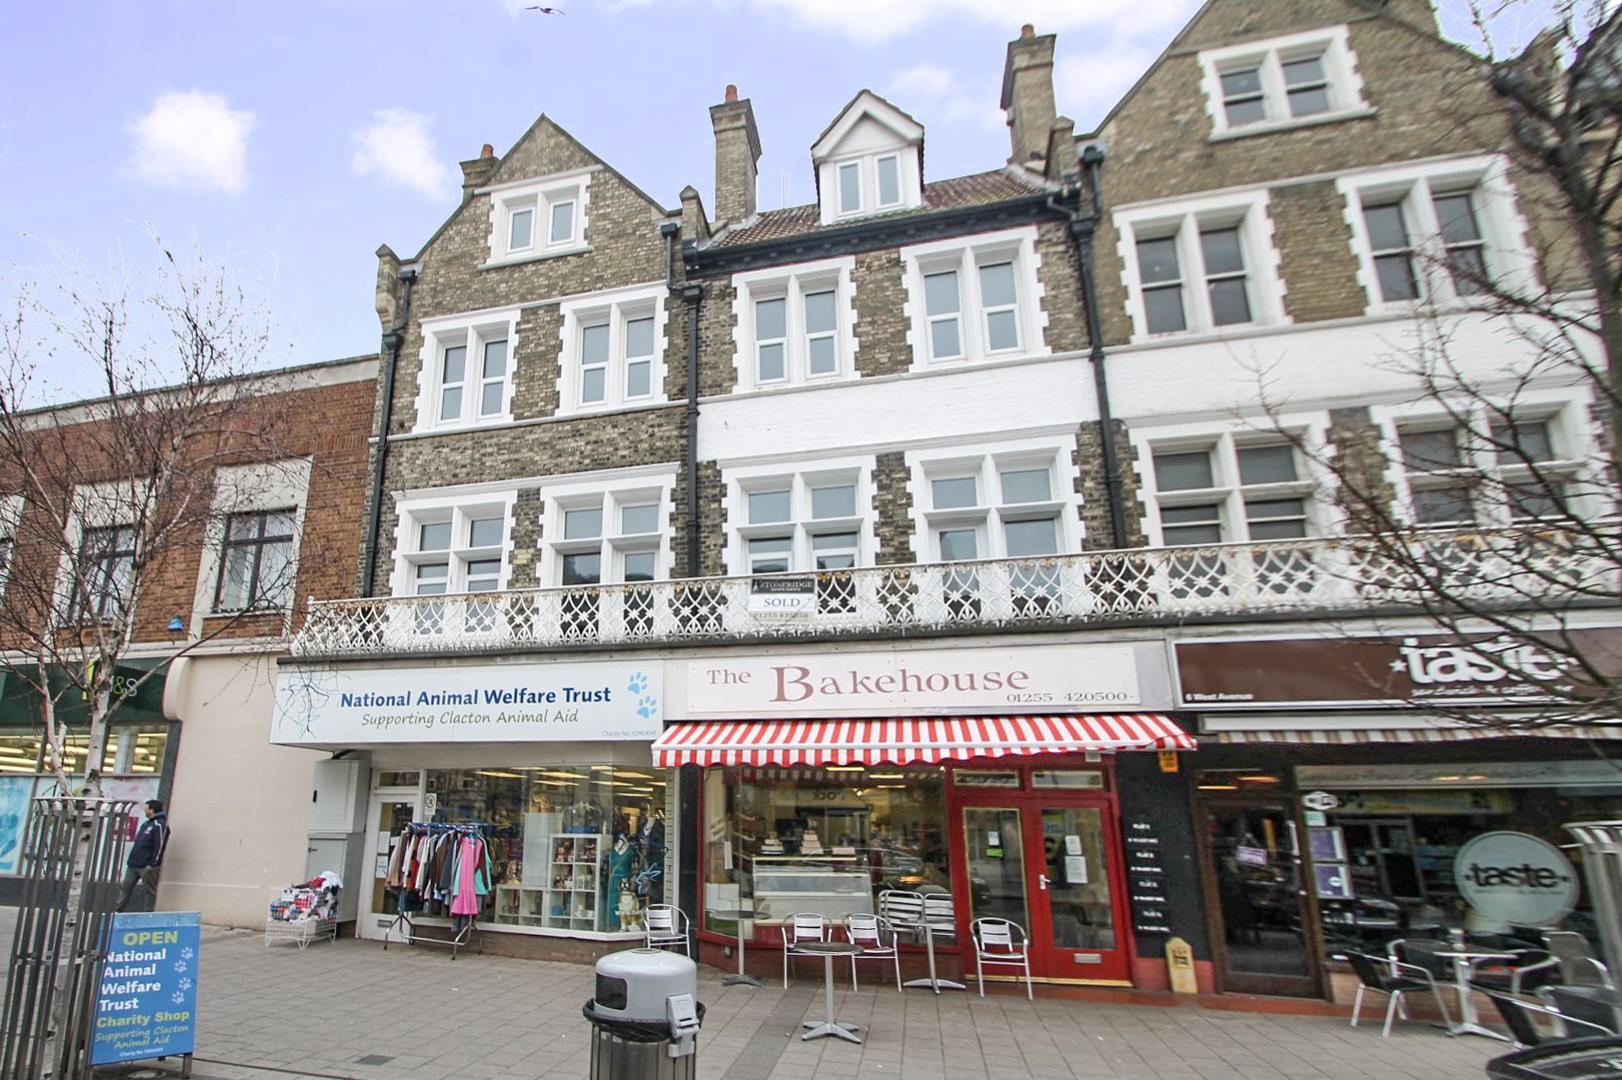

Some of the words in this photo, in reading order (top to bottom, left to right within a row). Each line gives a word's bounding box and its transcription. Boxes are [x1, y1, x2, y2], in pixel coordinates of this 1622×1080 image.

[763, 598, 801, 608] SOLD
[1400, 635, 1568, 684] taste
[706, 668, 752, 685] The
[768, 665, 1030, 702] Bakehouse
[340, 690, 411, 708] National
[416, 688, 479, 706] Animal
[484, 687, 556, 705] Welfare
[562, 687, 612, 703] Trust
[1006, 692, 1053, 703] 01255
[1064, 691, 1128, 702] 420500
[361, 711, 435, 730] Supporting
[439, 711, 491, 725] Clacton
[496, 709, 549, 724] Animal
[553, 708, 579, 723] Aid
[1469, 862, 1558, 888] taste
[123, 930, 178, 946] OPEN
[104, 963, 157, 978] Animal
[101, 980, 162, 995] Welfare
[100, 997, 140, 1012] Trust
[96, 1014, 150, 1028] Charity
[154, 1011, 190, 1023] Shop
[95, 1029, 151, 1042] Supporting
[153, 1025, 190, 1035] Clacton
[113, 1038, 150, 1049] Animal
[153, 1036, 170, 1045] Aid
